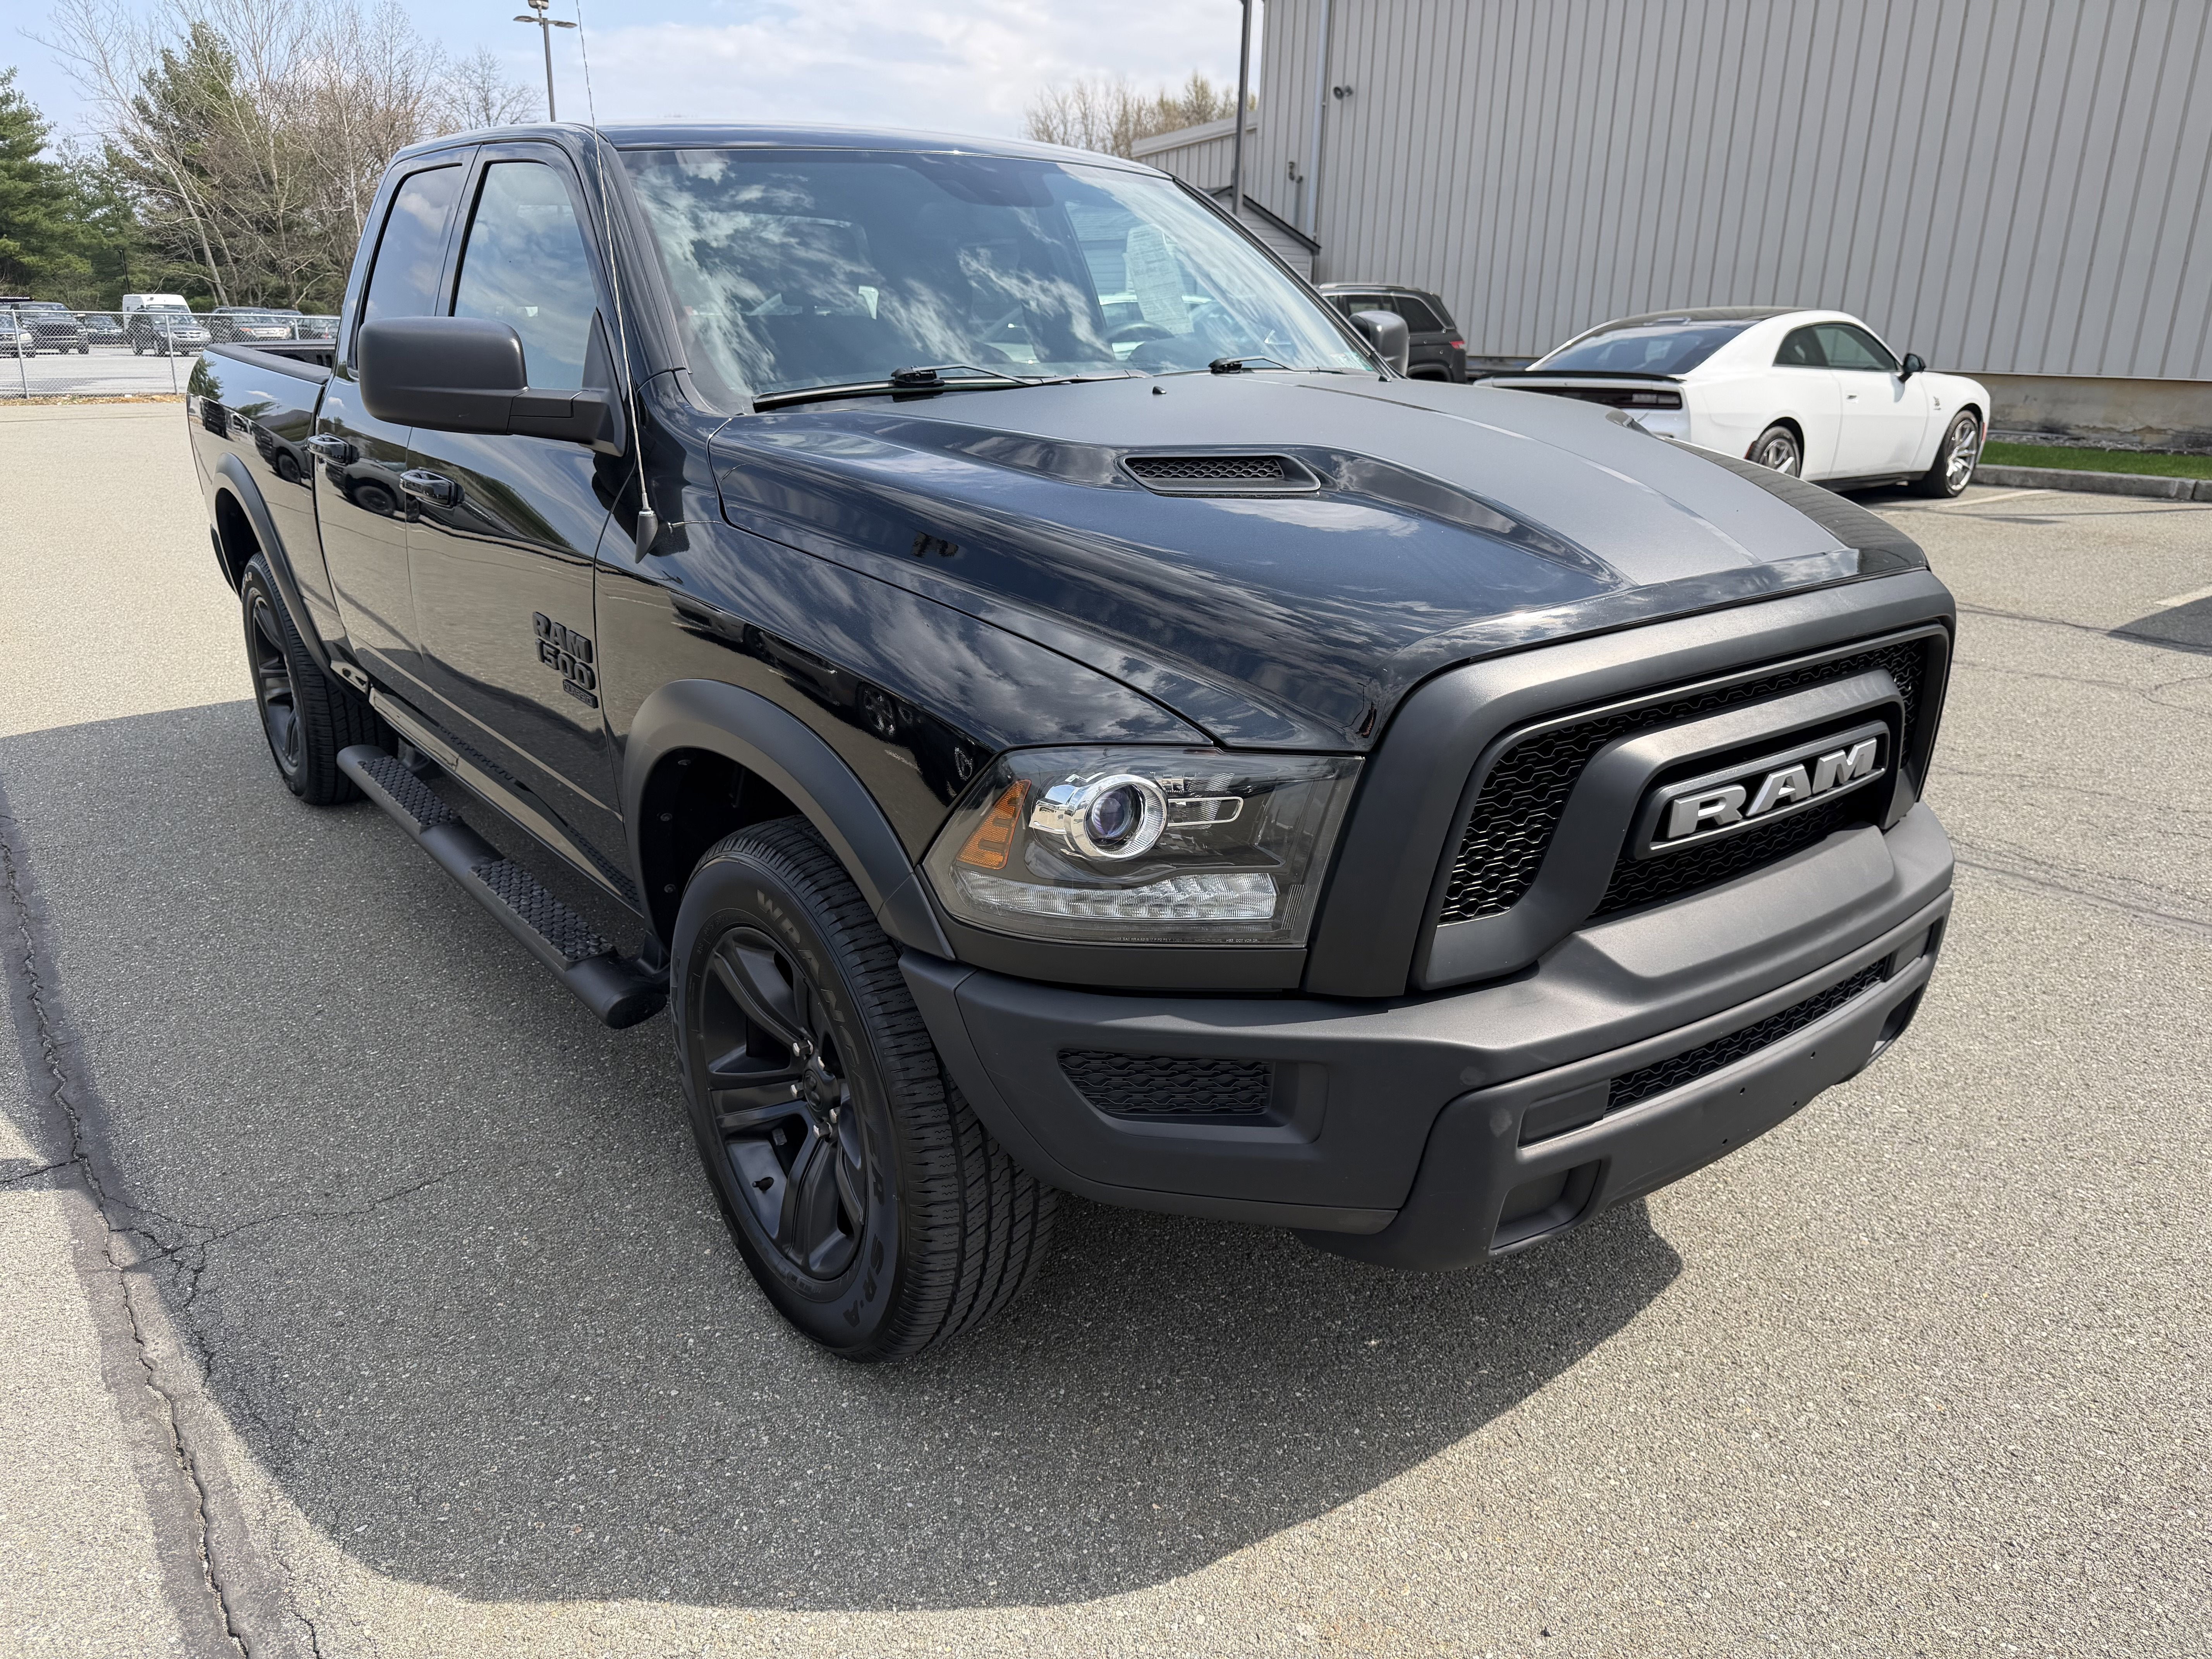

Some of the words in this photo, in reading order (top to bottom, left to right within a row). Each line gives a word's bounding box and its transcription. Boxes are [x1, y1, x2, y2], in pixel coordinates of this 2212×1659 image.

[532, 611, 593, 663] RAM
[535, 638, 596, 690] 1500
[563, 682, 593, 706] CLASSIC
[1666, 737, 1877, 840] RAM
[757, 888, 885, 1207] WRANGLER
[842, 1233, 884, 1328] SR-A
